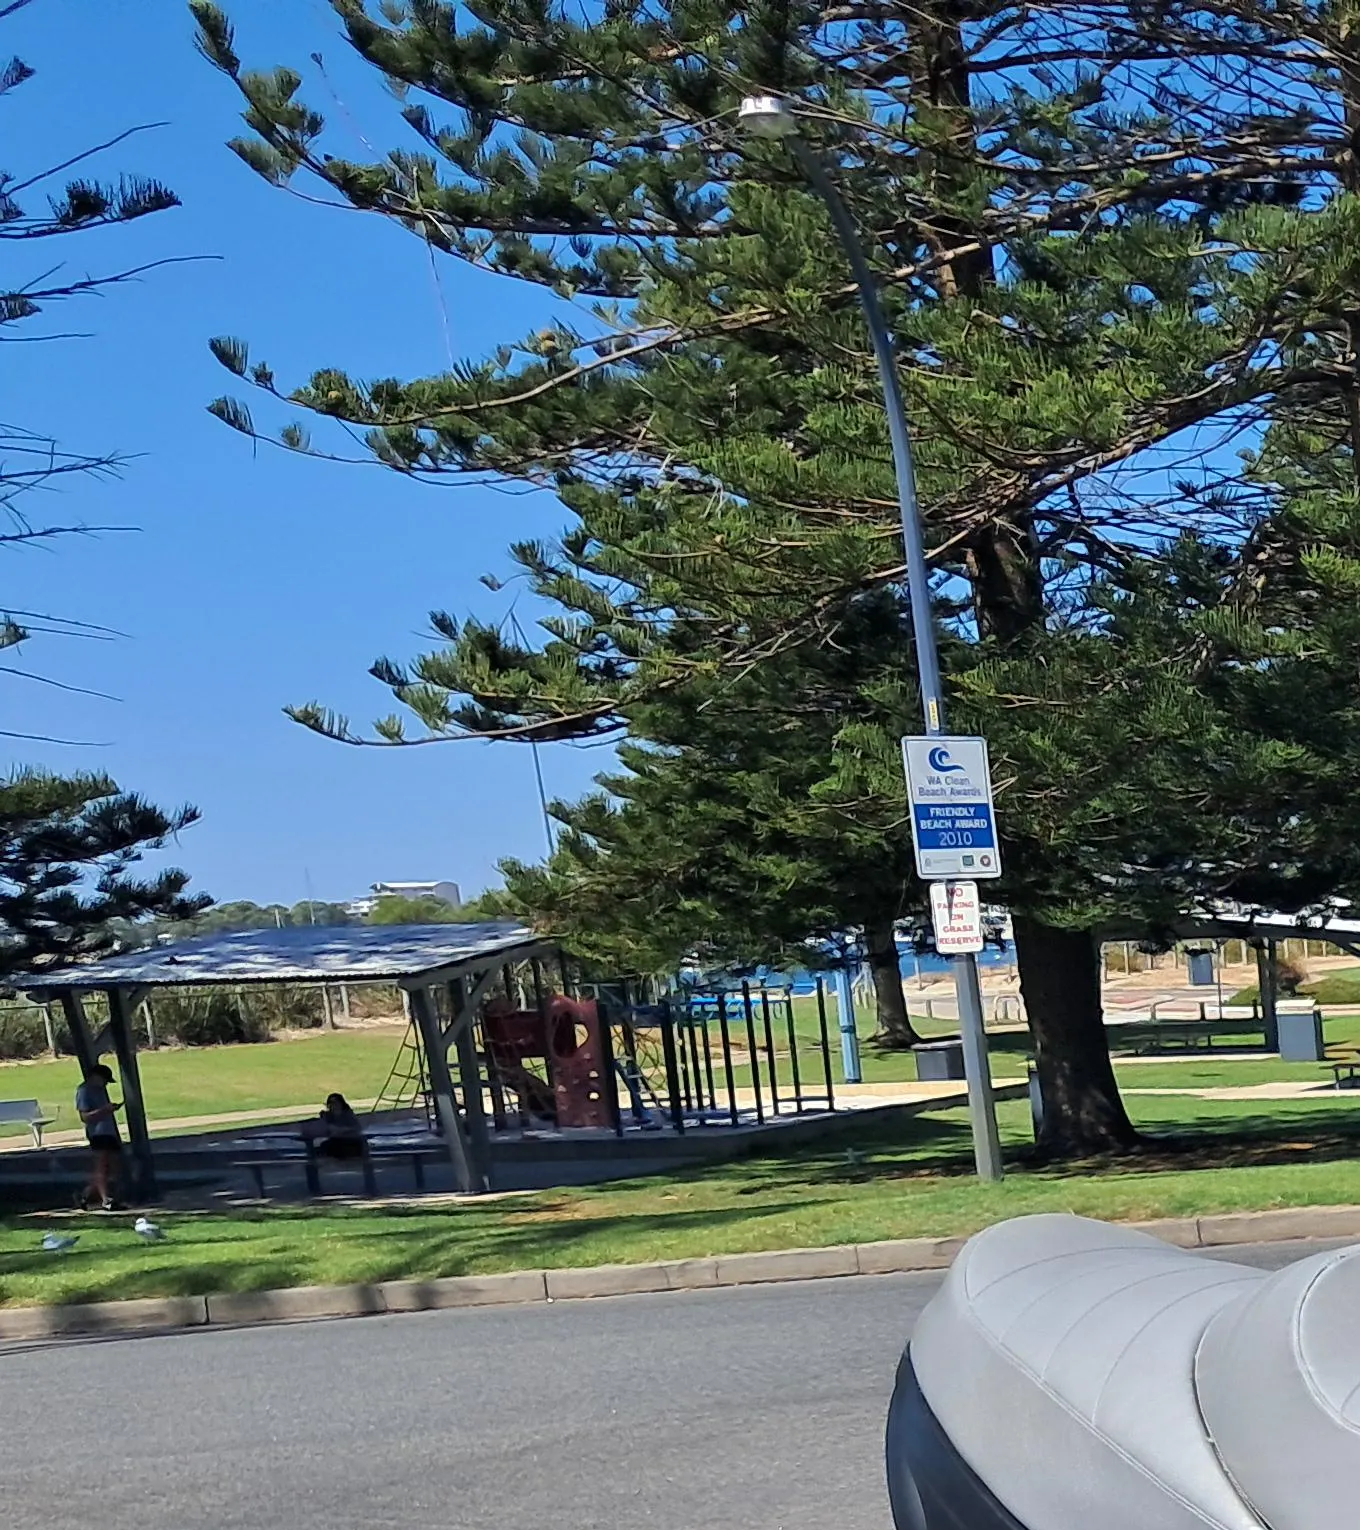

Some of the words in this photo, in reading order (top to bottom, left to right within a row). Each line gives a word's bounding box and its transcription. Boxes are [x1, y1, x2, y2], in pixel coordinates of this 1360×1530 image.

[927, 776, 942, 785] WA
[945, 776, 970, 785] Clean
[918, 787, 946, 796] Beach
[950, 787, 981, 796] Awards
[929, 807, 976, 817] FRIENDLY
[920, 819, 952, 830] BEACH
[955, 818, 988, 829] AWARD
[939, 832, 973, 846] 2010
[948, 887, 963, 897] NO
[937, 901, 974, 909] PARKING
[943, 925, 973, 933] GRASS
